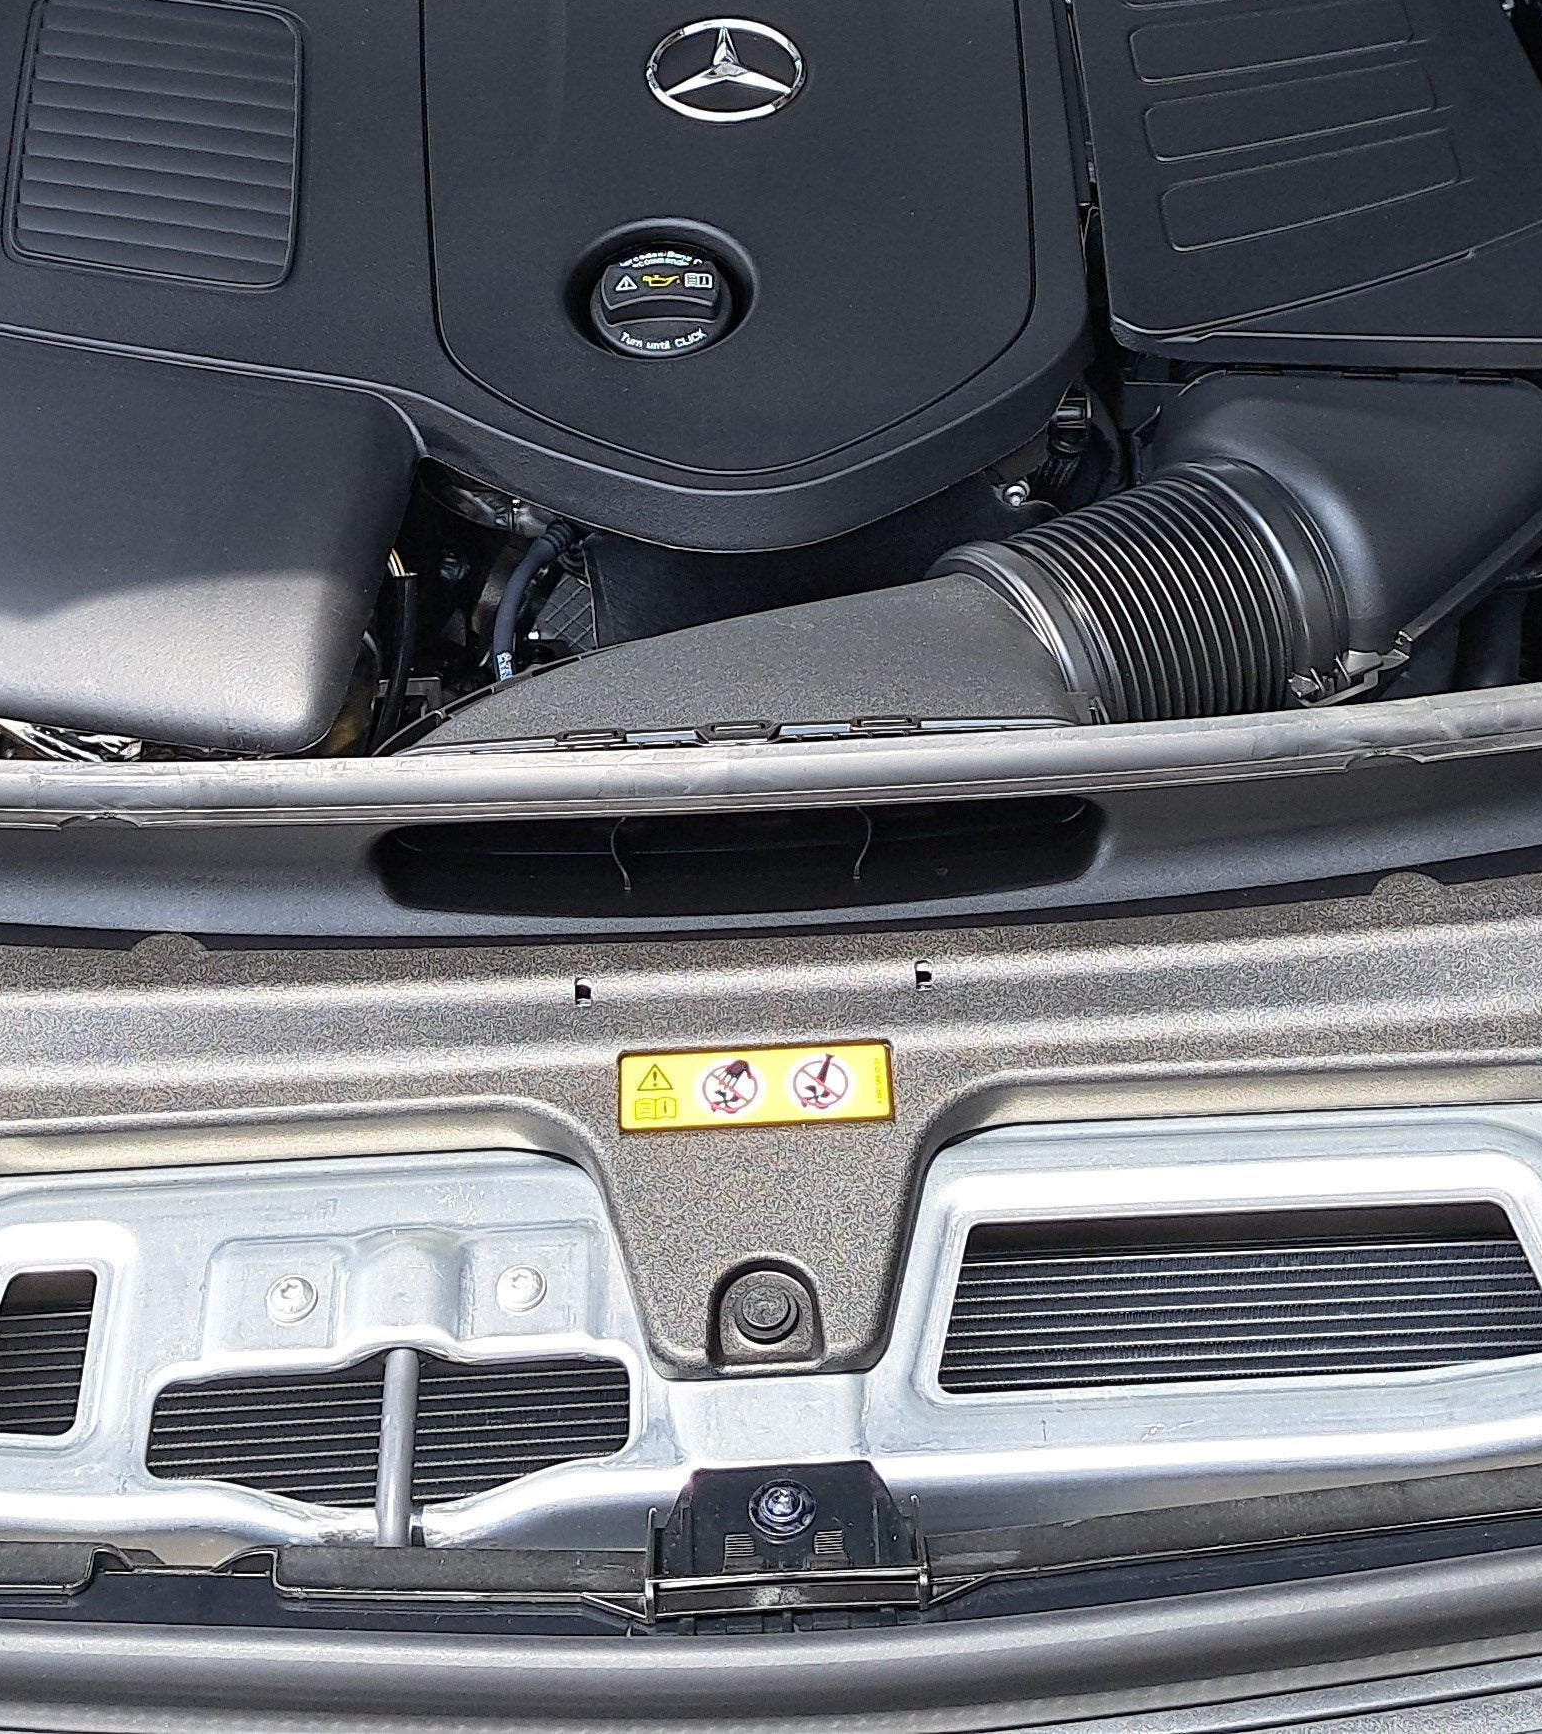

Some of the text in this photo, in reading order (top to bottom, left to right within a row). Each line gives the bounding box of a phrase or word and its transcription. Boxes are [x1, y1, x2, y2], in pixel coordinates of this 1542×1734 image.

[619, 327, 708, 349] Turn until CLICK
